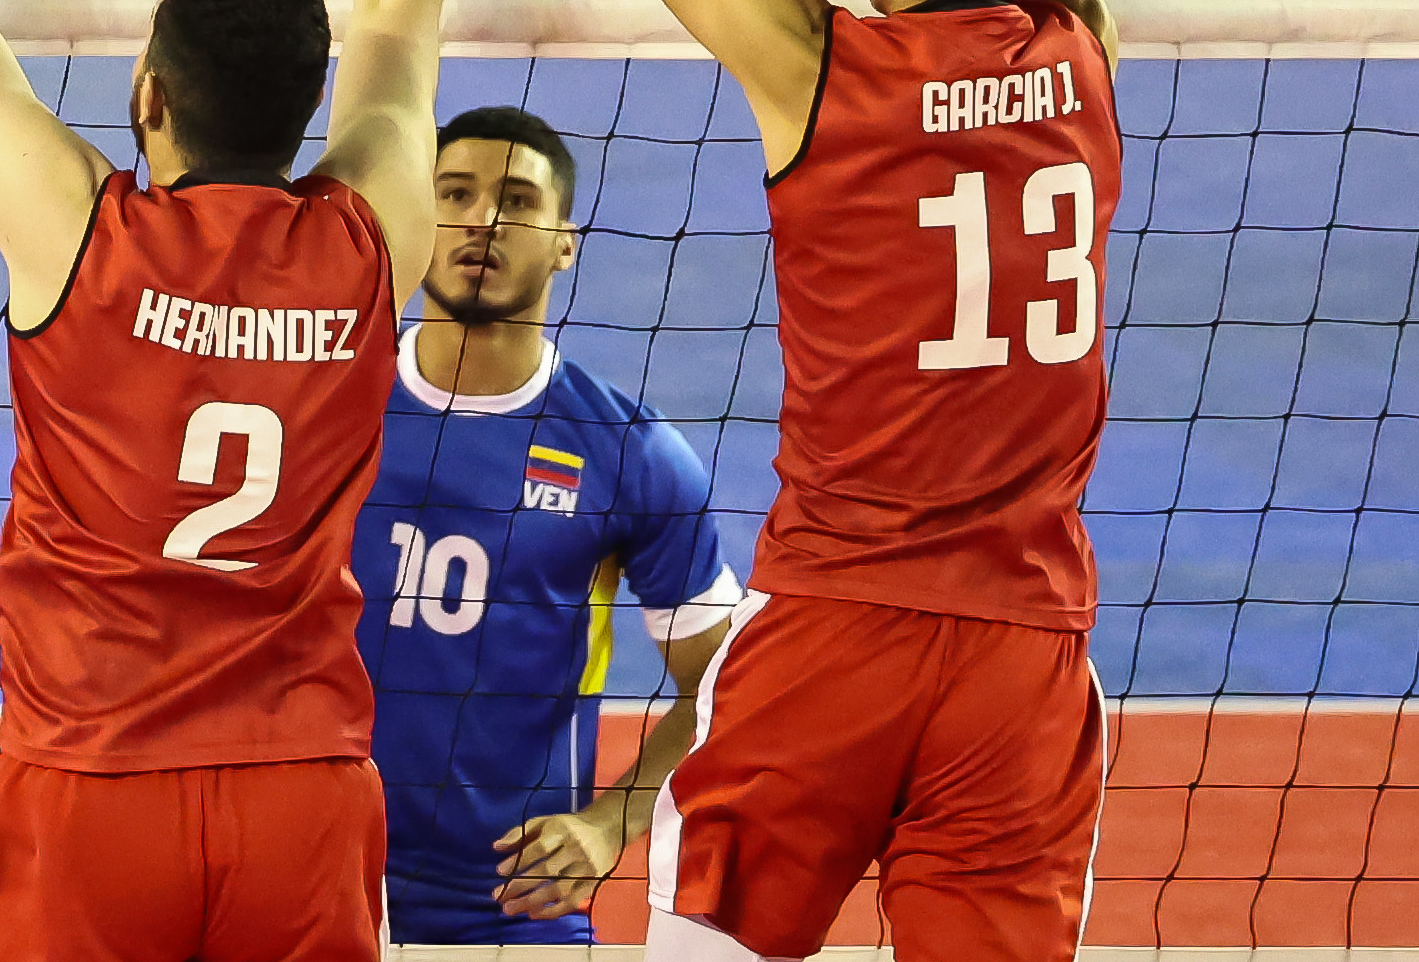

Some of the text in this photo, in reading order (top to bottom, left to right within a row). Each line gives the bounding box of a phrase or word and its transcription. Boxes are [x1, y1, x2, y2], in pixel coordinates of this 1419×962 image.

[921, 59, 1083, 133] GARCIA J.
[917, 161, 1098, 371] 13
[132, 287, 358, 362] HERNANDEZ
[161, 400, 284, 573] 2
[523, 479, 579, 518] VEN
[389, 521, 491, 636] 10
